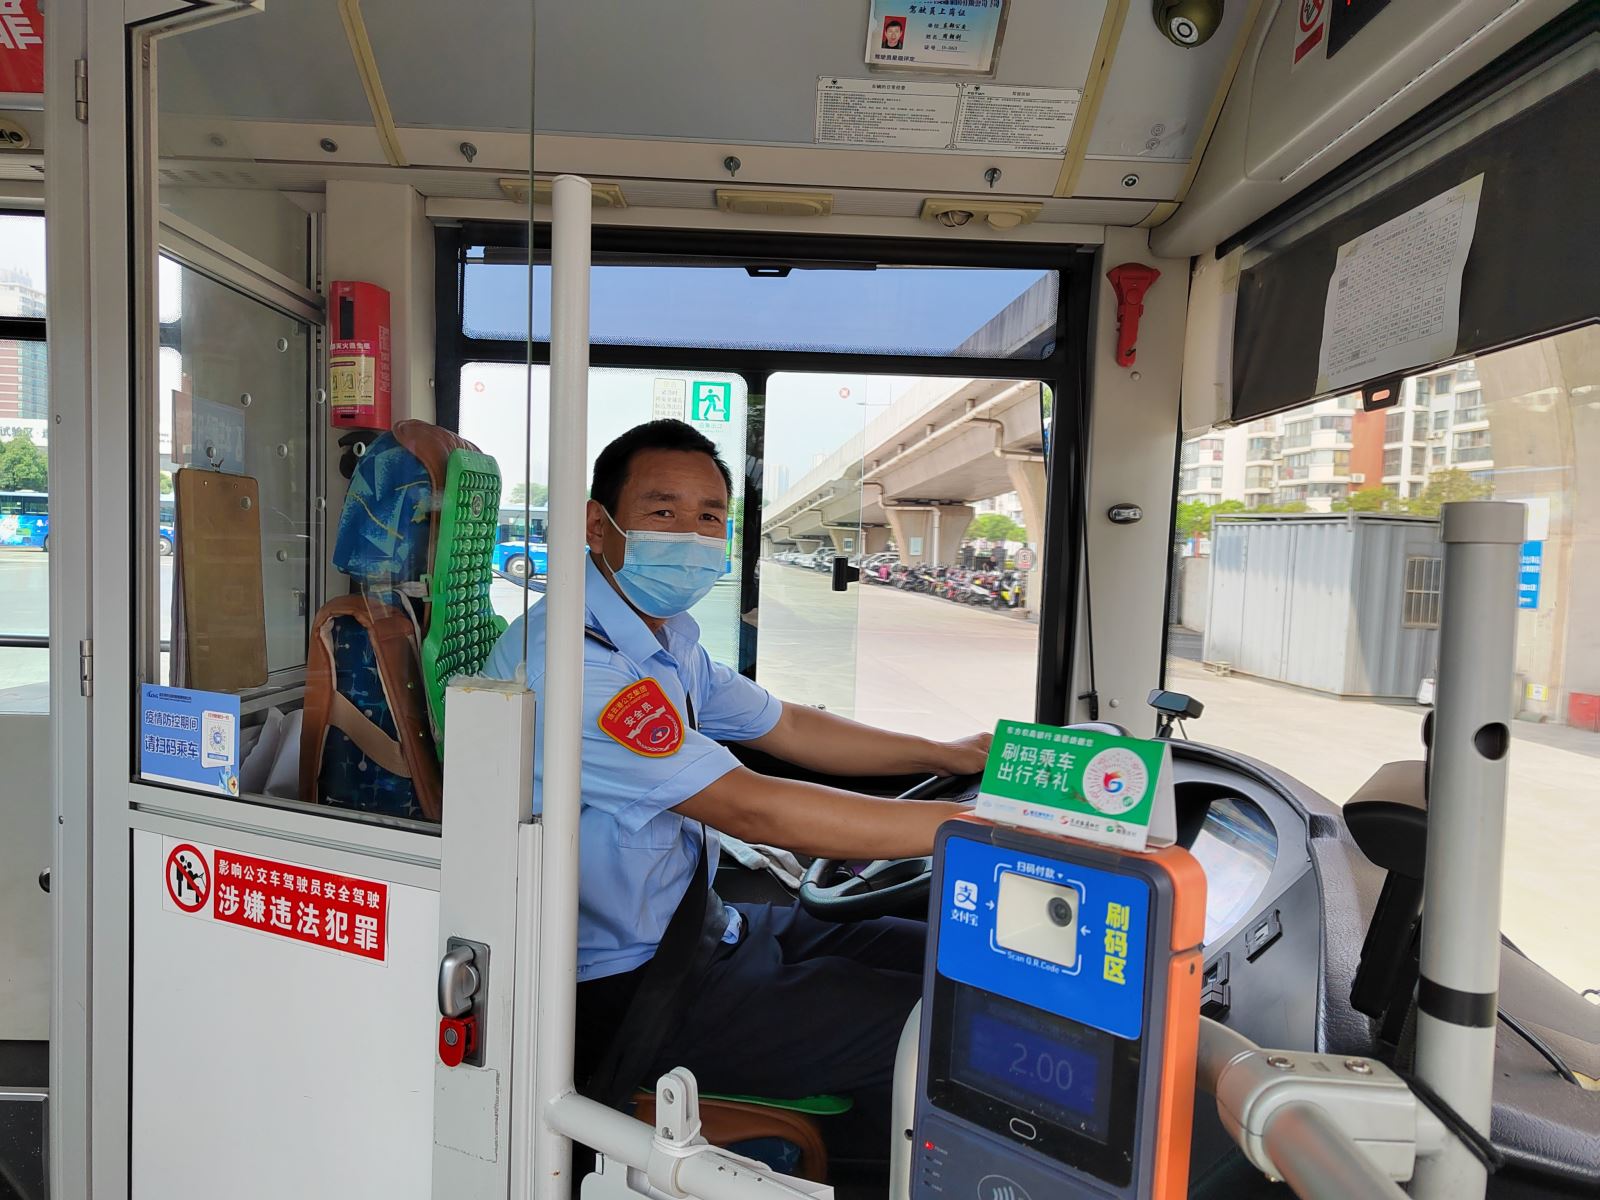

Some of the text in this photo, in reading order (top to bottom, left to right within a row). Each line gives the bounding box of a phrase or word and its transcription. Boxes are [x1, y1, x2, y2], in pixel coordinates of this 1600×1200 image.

[145, 709, 199, 732] 疫情防控期间
[623, 702, 654, 728] 安全员
[144, 734, 199, 760] 请扫码乘车
[1001, 742, 1076, 771] 刷码乘车
[997, 762, 1070, 793] 出行有礼
[218, 858, 380, 910] 影响公交车驾驶员安全驾驶
[1016, 861, 1055, 880] 扫码付款
[217, 883, 379, 951] 涉嫌违法犯罪
[950, 909, 979, 927] 支付宝
[1103, 901, 1130, 985] 刷码区
[1007, 951, 1025, 963] Scan
[1010, 1042, 1073, 1090] 2.00
